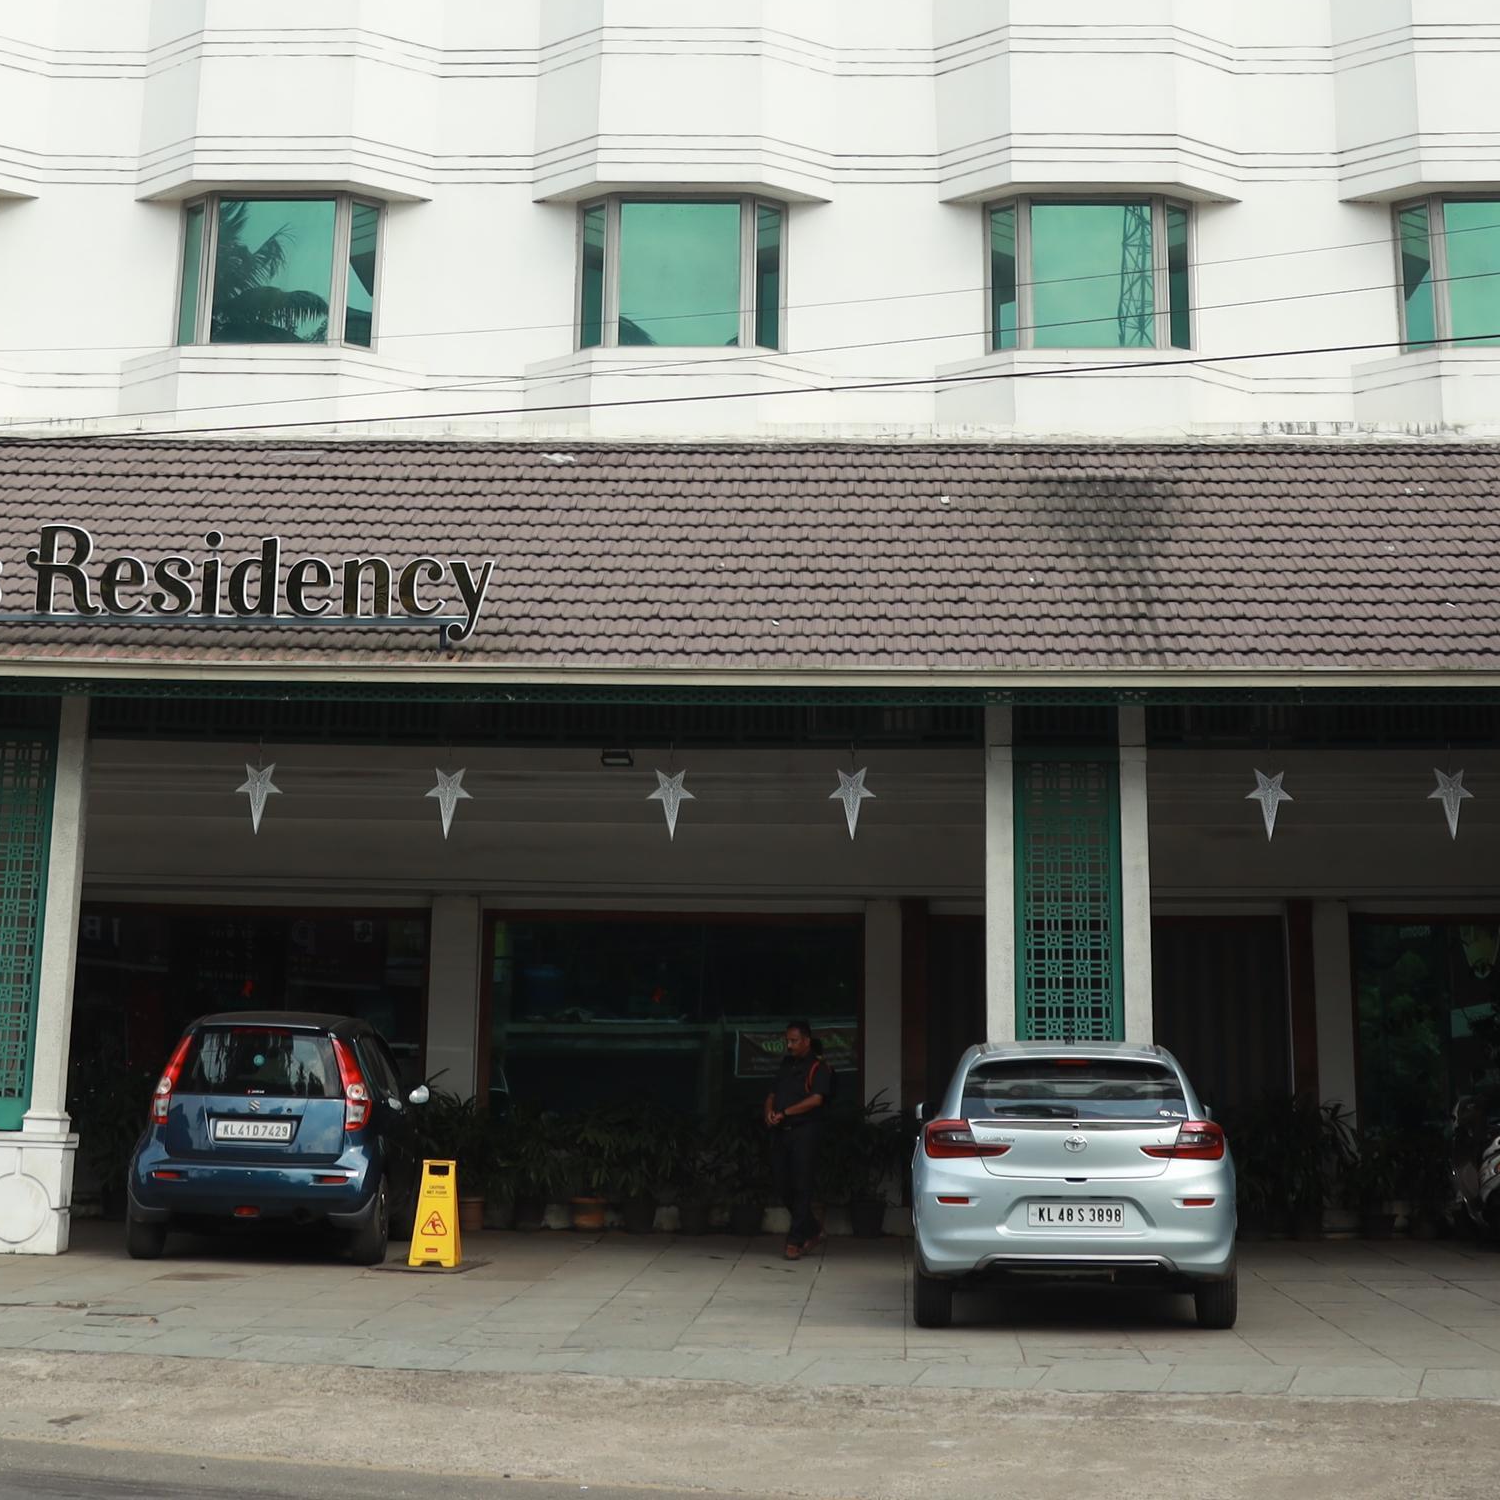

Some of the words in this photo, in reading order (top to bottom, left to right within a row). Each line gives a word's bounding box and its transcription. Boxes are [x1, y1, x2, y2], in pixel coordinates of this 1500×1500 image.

[26, 522, 496, 642] Residency
[1038, 1207, 1054, 1222] KL
[1058, 1208, 1074, 1222] 48
[1078, 1208, 1085, 1222] S
[1089, 1208, 1122, 1222] 3898
